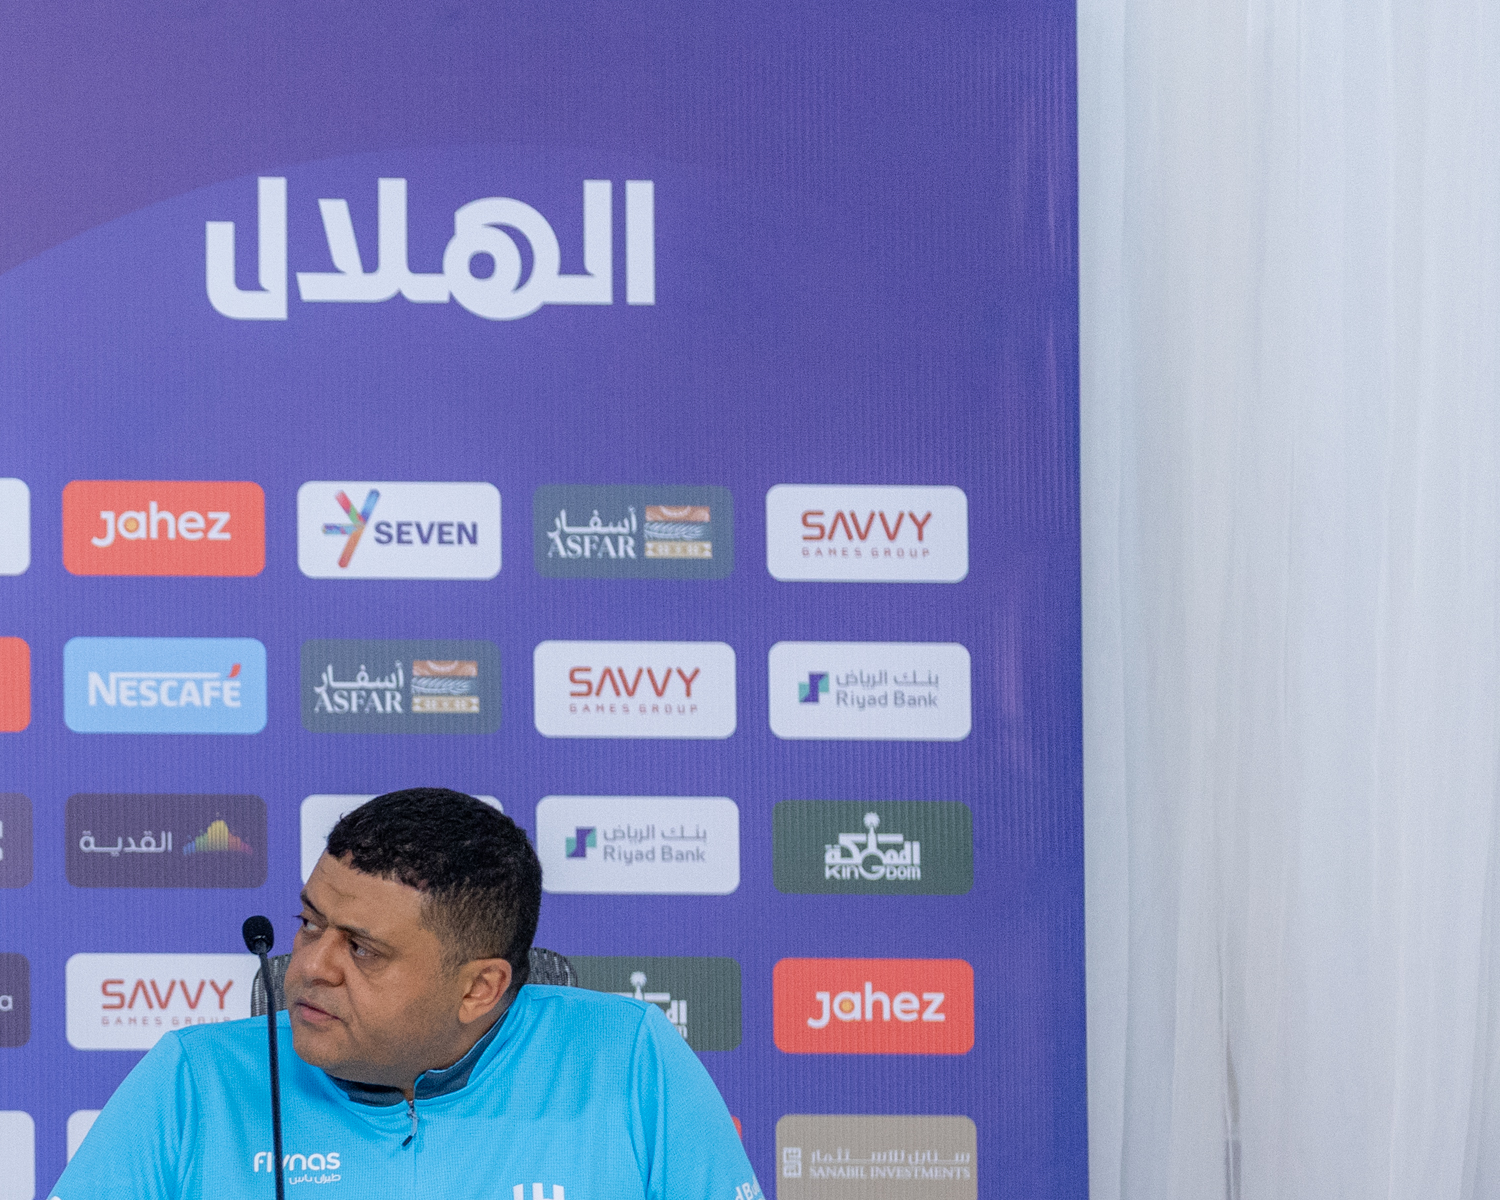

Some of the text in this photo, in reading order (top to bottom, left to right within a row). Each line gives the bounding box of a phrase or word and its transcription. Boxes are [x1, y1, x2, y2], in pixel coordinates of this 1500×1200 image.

[205, 176, 655, 321] الهلال
[91, 501, 231, 547] jahez
[373, 521, 478, 545] SEVEN
[802, 510, 932, 541] SAVVY
[547, 535, 636, 559] ASFAR
[802, 547, 931, 558] GAMES GROUP
[87, 663, 242, 708] NESCAFÉ
[569, 667, 700, 697] SAVVY
[314, 690, 404, 713] ASFAR
[569, 704, 699, 714] GAMES GROUP
[836, 690, 938, 710] Riyad Bank
[79, 831, 173, 857] القدية
[603, 845, 706, 864] Riyad Bank
[101, 978, 234, 1010] SAVVY
[807, 982, 945, 1029] jahez
[102, 1016, 162, 1026] GAMES
[810, 1165, 971, 1180] SANABIL INVESTMENTS
